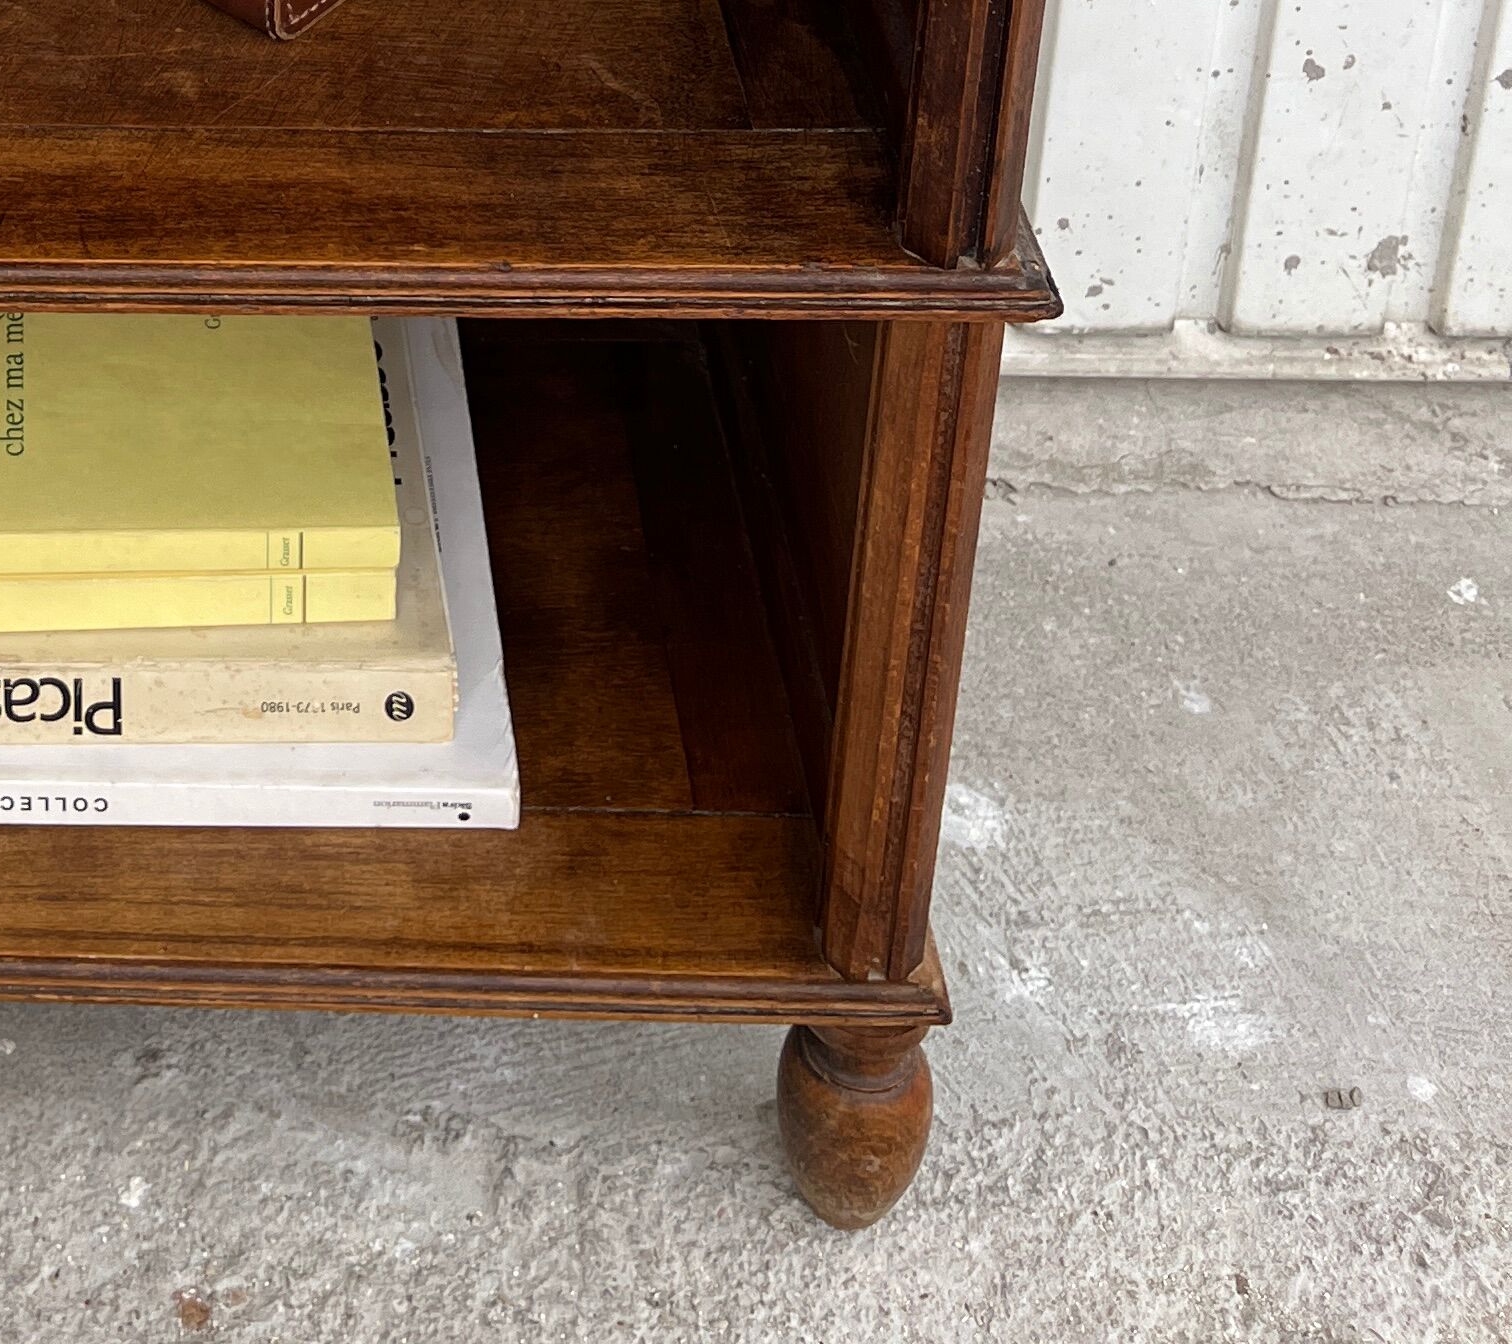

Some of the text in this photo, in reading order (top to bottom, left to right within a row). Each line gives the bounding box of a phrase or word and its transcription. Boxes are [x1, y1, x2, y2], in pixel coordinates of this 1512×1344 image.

[4, 352, 25, 389] ma
[330, 701, 361, 714] Paris
[372, 800, 442, 811] Flammarion
